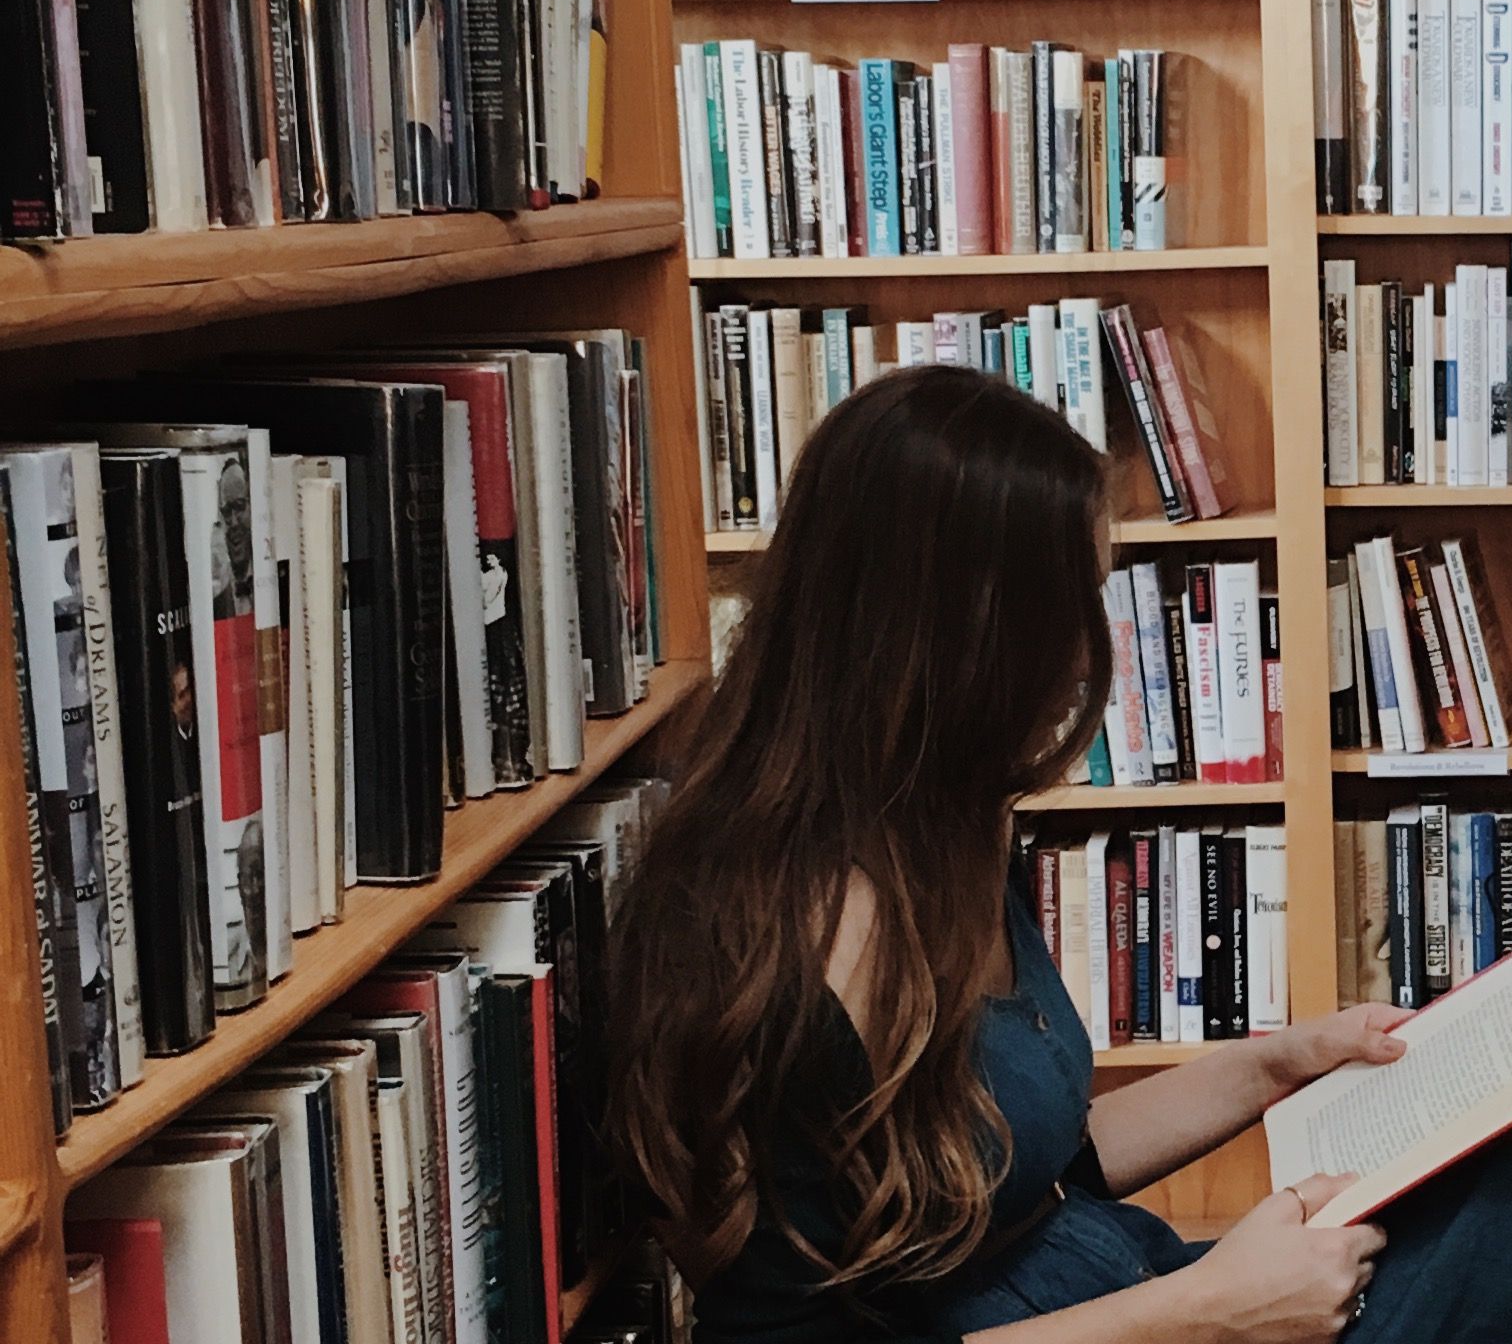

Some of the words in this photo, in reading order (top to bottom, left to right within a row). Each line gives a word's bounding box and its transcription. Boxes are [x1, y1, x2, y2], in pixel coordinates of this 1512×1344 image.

[732, 50, 746, 76] The
[735, 79, 750, 123] Labor
[938, 88, 948, 108] THE
[736, 123, 756, 175] History
[940, 112, 952, 163] PULLMAN
[739, 178, 753, 228] Reader
[942, 167, 954, 206] STRIKE
[84, 595, 100, 614] of
[1146, 591, 1158, 628] BLOOD
[1151, 635, 1162, 658] AND
[88, 622, 112, 742] DREAMS
[1155, 662, 1170, 729] BELONGING
[1206, 845, 1217, 866] SEE
[103, 803, 128, 948] SALAMON
[1115, 880, 1127, 898] AL
[1207, 869, 1218, 890] NO
[1207, 893, 1219, 923] EVIL
[393, 1207, 418, 1274] Hugh
